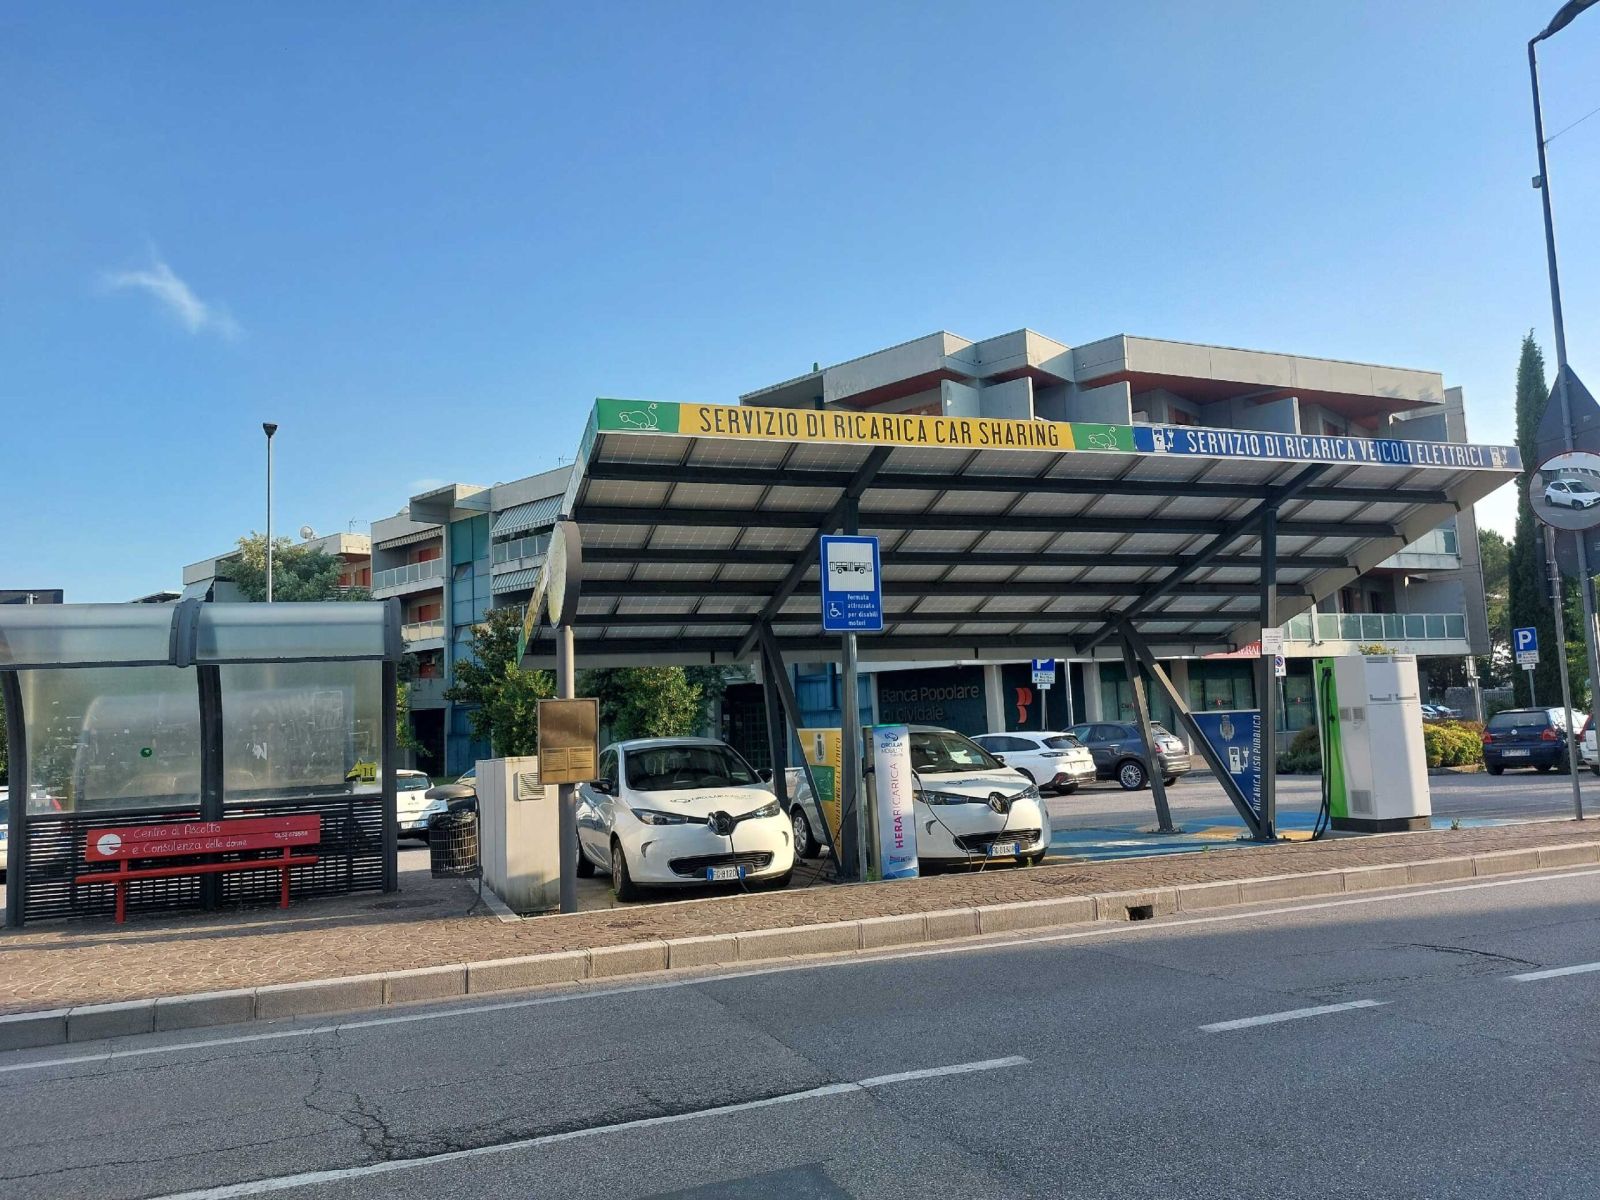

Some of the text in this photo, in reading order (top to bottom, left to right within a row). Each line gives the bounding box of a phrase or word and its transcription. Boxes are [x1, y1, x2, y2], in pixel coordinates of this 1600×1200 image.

[699, 406, 1059, 447] SERVIZIO DI RICARICA CAR SHARING
[1187, 431, 1484, 466] SERVIZIO DI RICARICA VEICOLI ELETTRICI
[1518, 631, 1532, 650] P
[881, 684, 980, 703] Banca Popolare
[1253, 715, 1261, 811] RICARICA USO PUBBLICO
[133, 826, 167, 839] Centro
[184, 822, 221, 836] Ascolto
[132, 845, 140, 855] e
[143, 840, 202, 854] Consulenza
[205, 838, 223, 849] delle
